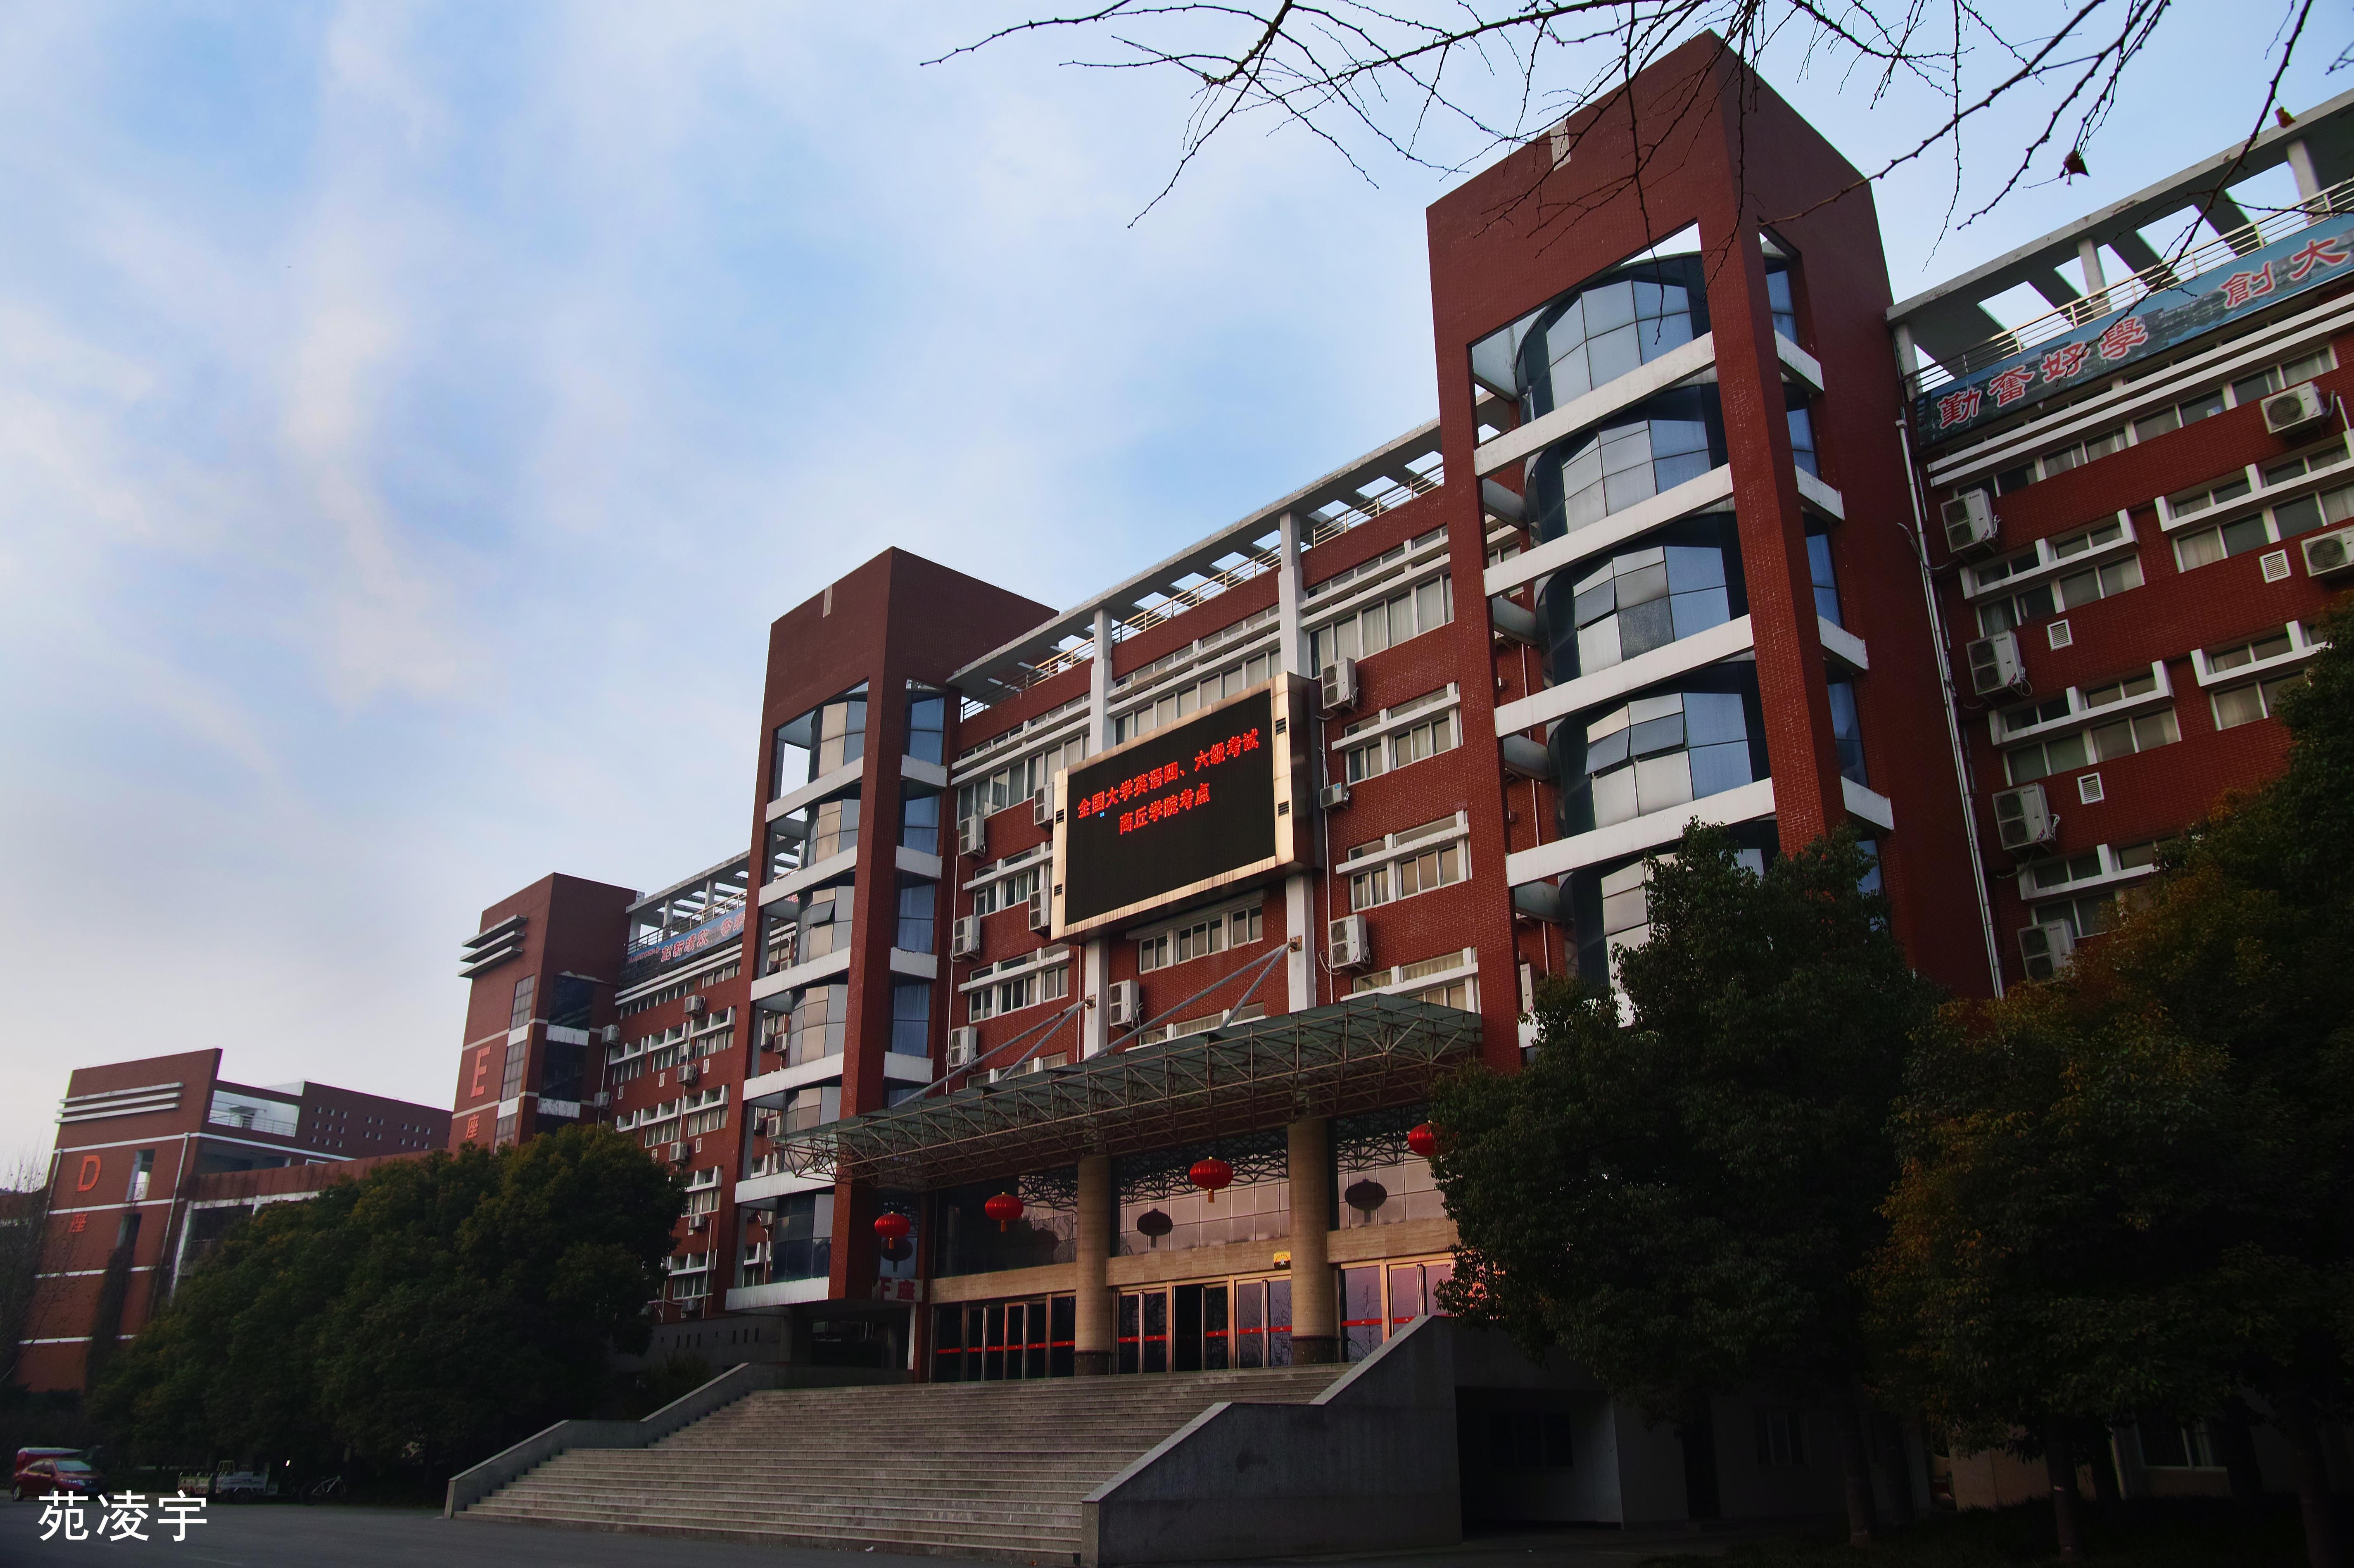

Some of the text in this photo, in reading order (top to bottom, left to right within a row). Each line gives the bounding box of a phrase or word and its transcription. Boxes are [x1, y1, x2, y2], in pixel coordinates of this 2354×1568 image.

[1078, 728, 1259, 819] 全国大学英语四、六级考试
[1119, 783, 1211, 835] 商丘学院考点
[470, 1045, 491, 1098] E
[466, 1114, 480, 1140] 座
[77, 1155, 101, 1192] D
